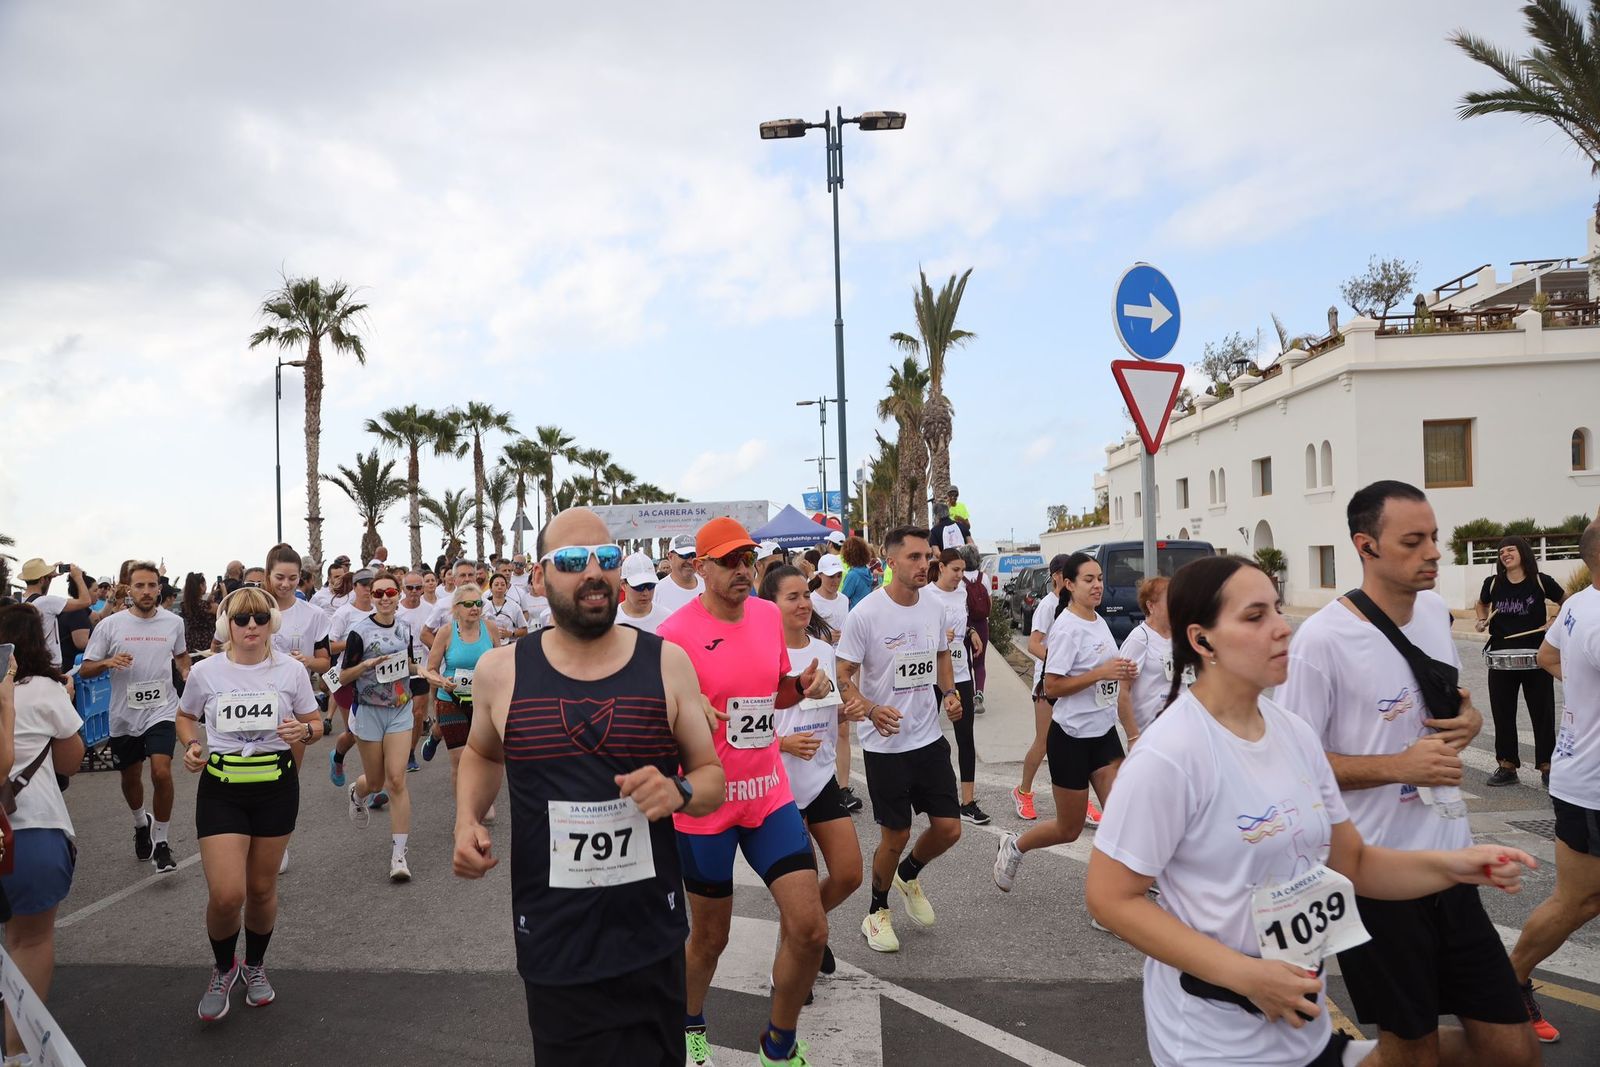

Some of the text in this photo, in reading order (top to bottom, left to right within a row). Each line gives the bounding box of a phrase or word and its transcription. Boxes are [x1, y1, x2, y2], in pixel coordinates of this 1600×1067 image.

[652, 508, 694, 516] CARRERA
[379, 660, 406, 675] 1117
[899, 661, 933, 677] 1286
[135, 689, 160, 701] 952
[1101, 681, 1118, 695] 857
[222, 704, 273, 719] 1044
[581, 803, 618, 813] CARRERA
[569, 827, 632, 861] 797
[1271, 890, 1283, 899] 3A
[1284, 875, 1318, 895] CARRERA
[1265, 892, 1345, 950] 1039
